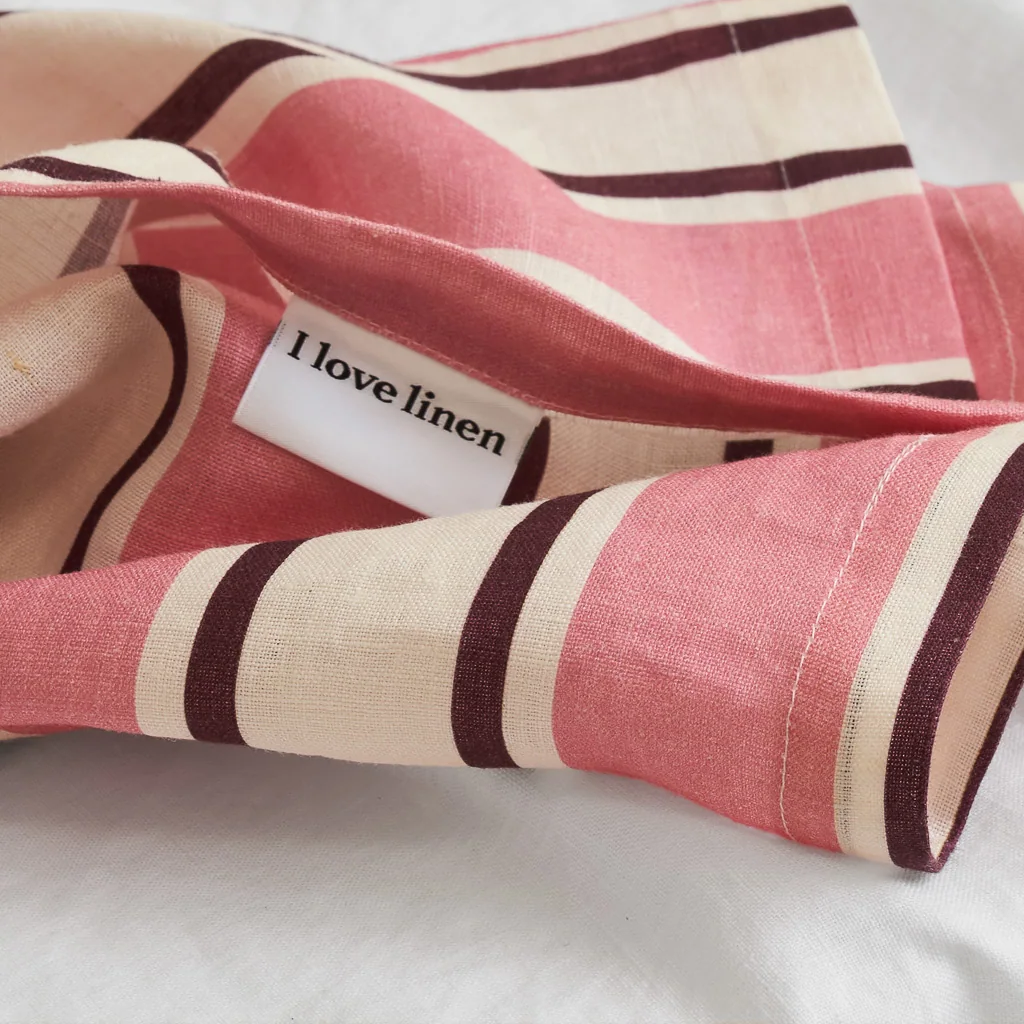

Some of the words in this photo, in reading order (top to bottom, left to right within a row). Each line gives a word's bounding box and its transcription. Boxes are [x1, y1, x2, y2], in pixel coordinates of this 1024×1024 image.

[287, 329, 309, 361] I
[310, 341, 398, 404] love
[400, 384, 506, 457] linen
